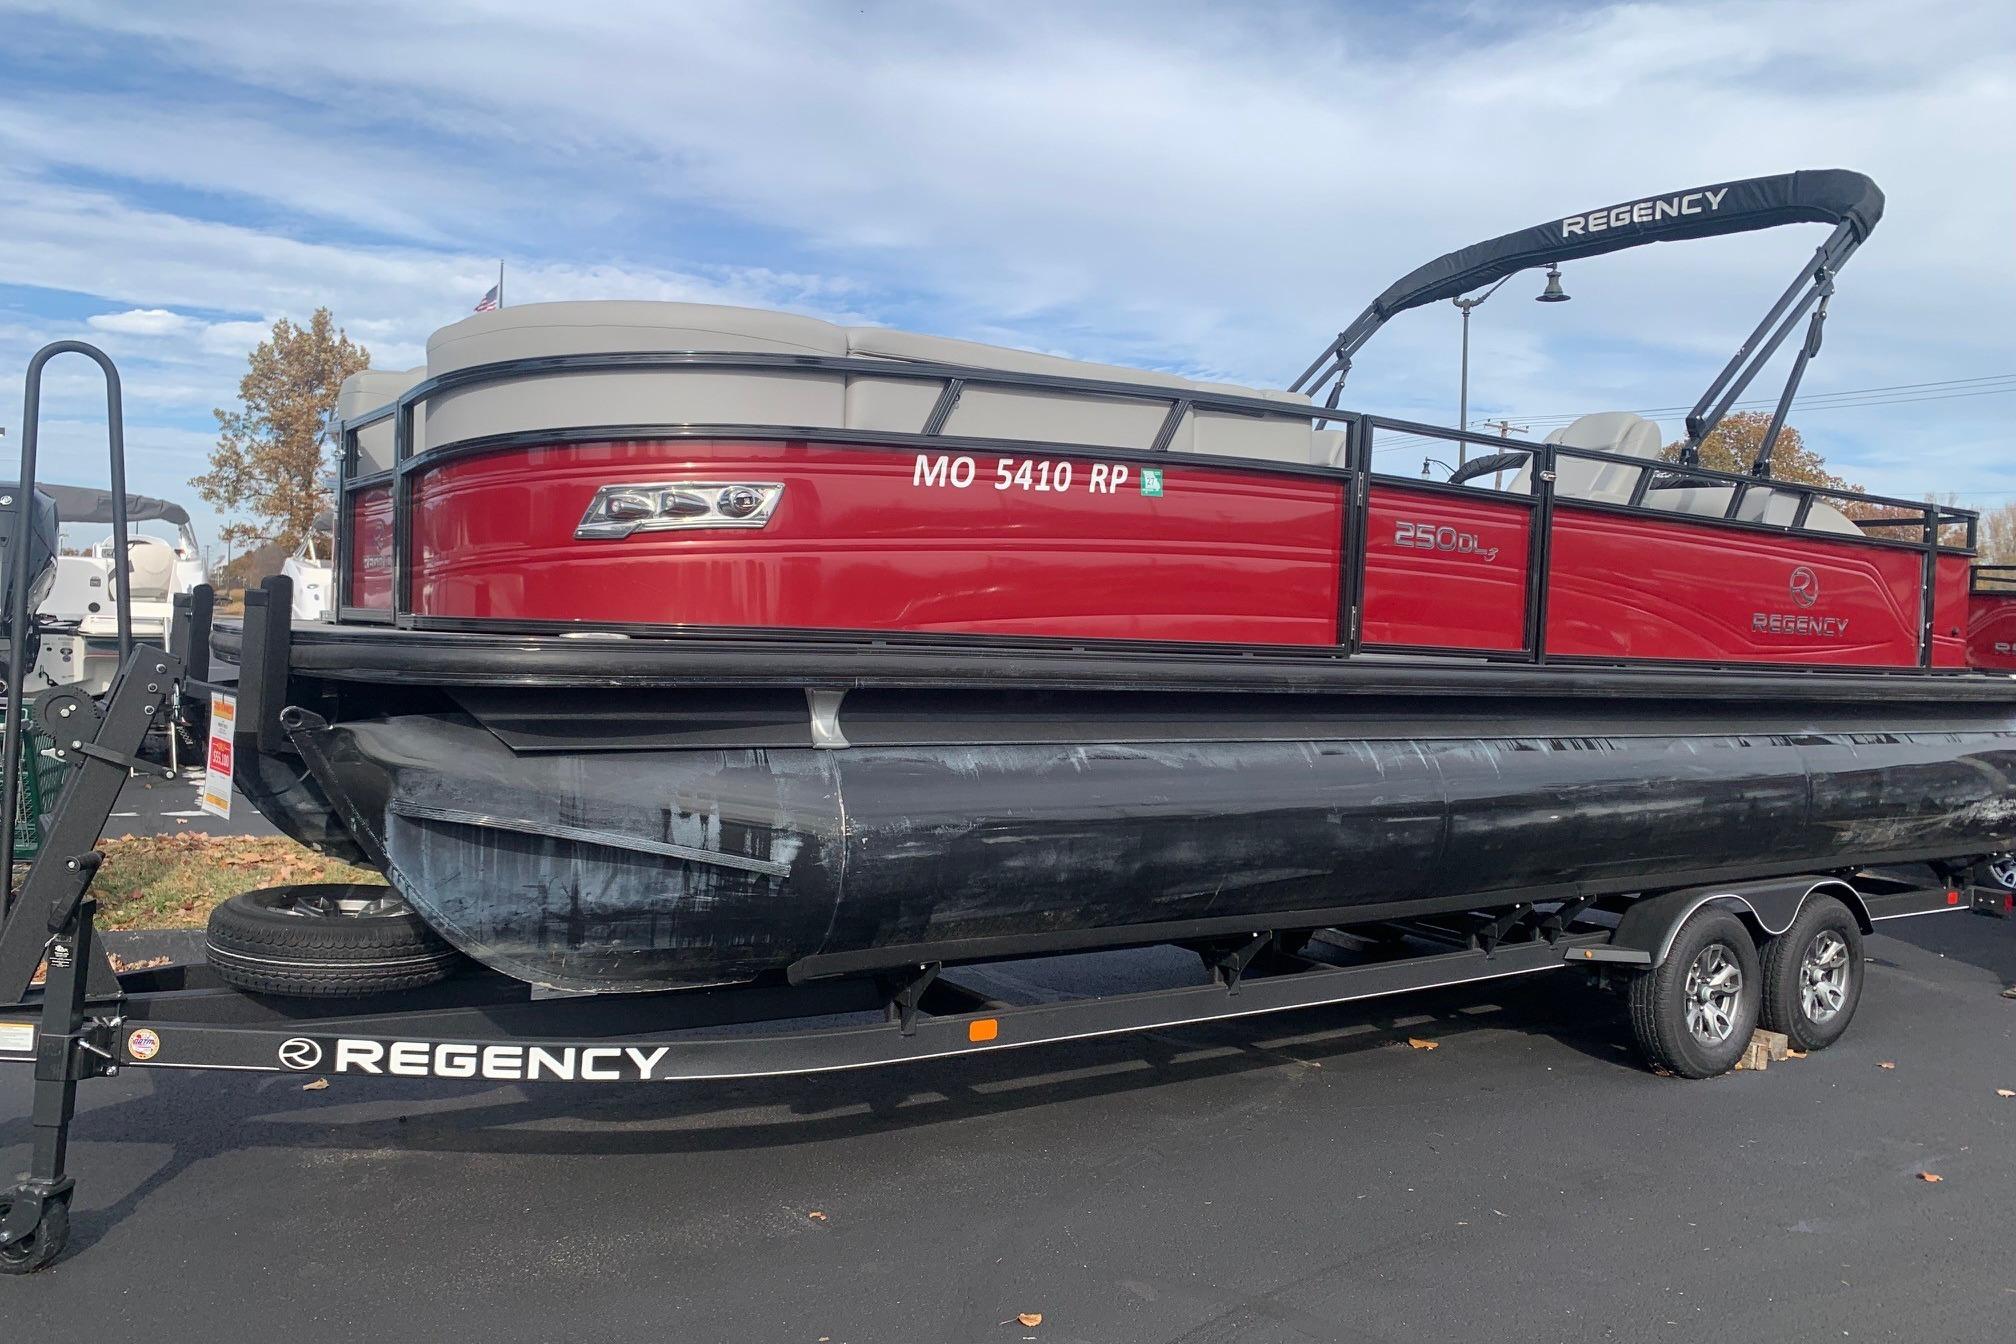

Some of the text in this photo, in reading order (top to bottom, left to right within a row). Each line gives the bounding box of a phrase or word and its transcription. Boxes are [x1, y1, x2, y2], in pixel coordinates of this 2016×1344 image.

[1562, 188, 1728, 238] REGENCY
[913, 454, 1128, 493] MO 5410 RP
[1752, 612, 1849, 638] REGENCY
[336, 1038, 670, 1080] REGENCY
